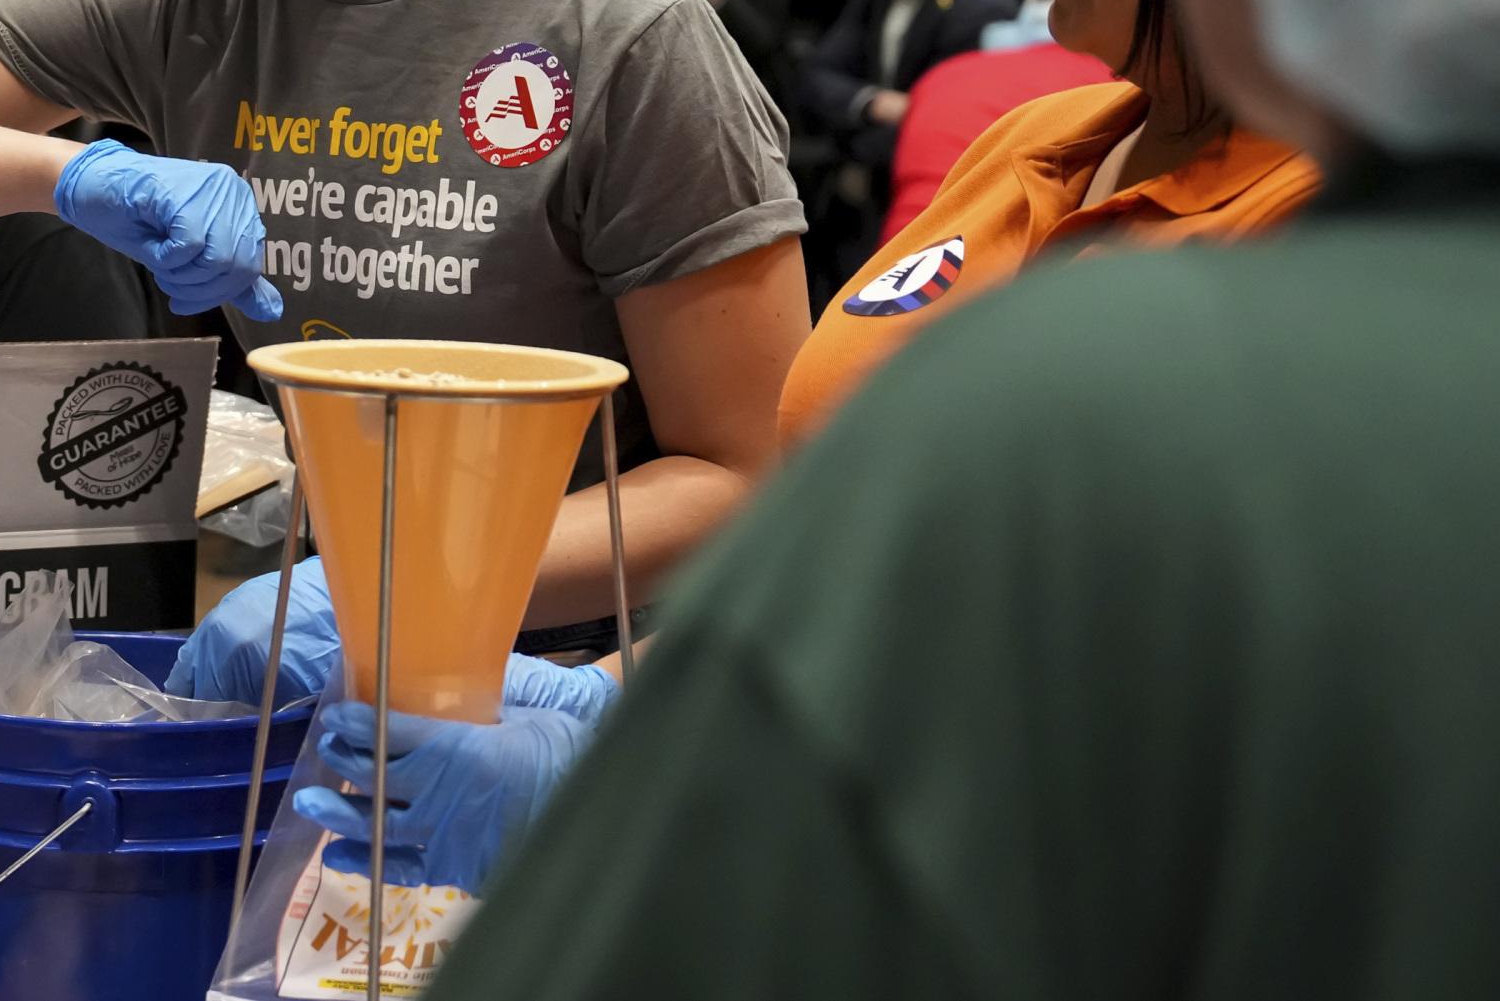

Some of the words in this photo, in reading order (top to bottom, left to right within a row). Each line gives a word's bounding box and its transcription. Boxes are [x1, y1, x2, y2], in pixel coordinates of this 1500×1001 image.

[234, 100, 321, 155] Never
[329, 106, 443, 175] forget
[502, 146, 537, 160] AmeriCorps
[251, 167, 346, 220] we're
[354, 178, 499, 239] capable
[320, 236, 480, 300] together
[50, 395, 180, 471] GUARANTEE
[56, 388, 89, 436] PACKED
[89, 374, 122, 391] WITH
[124, 375, 155, 392] LOVE
[74, 477, 122, 496] PACKED
[124, 467, 155, 491] WITH
[151, 432, 171, 466] LOVE
